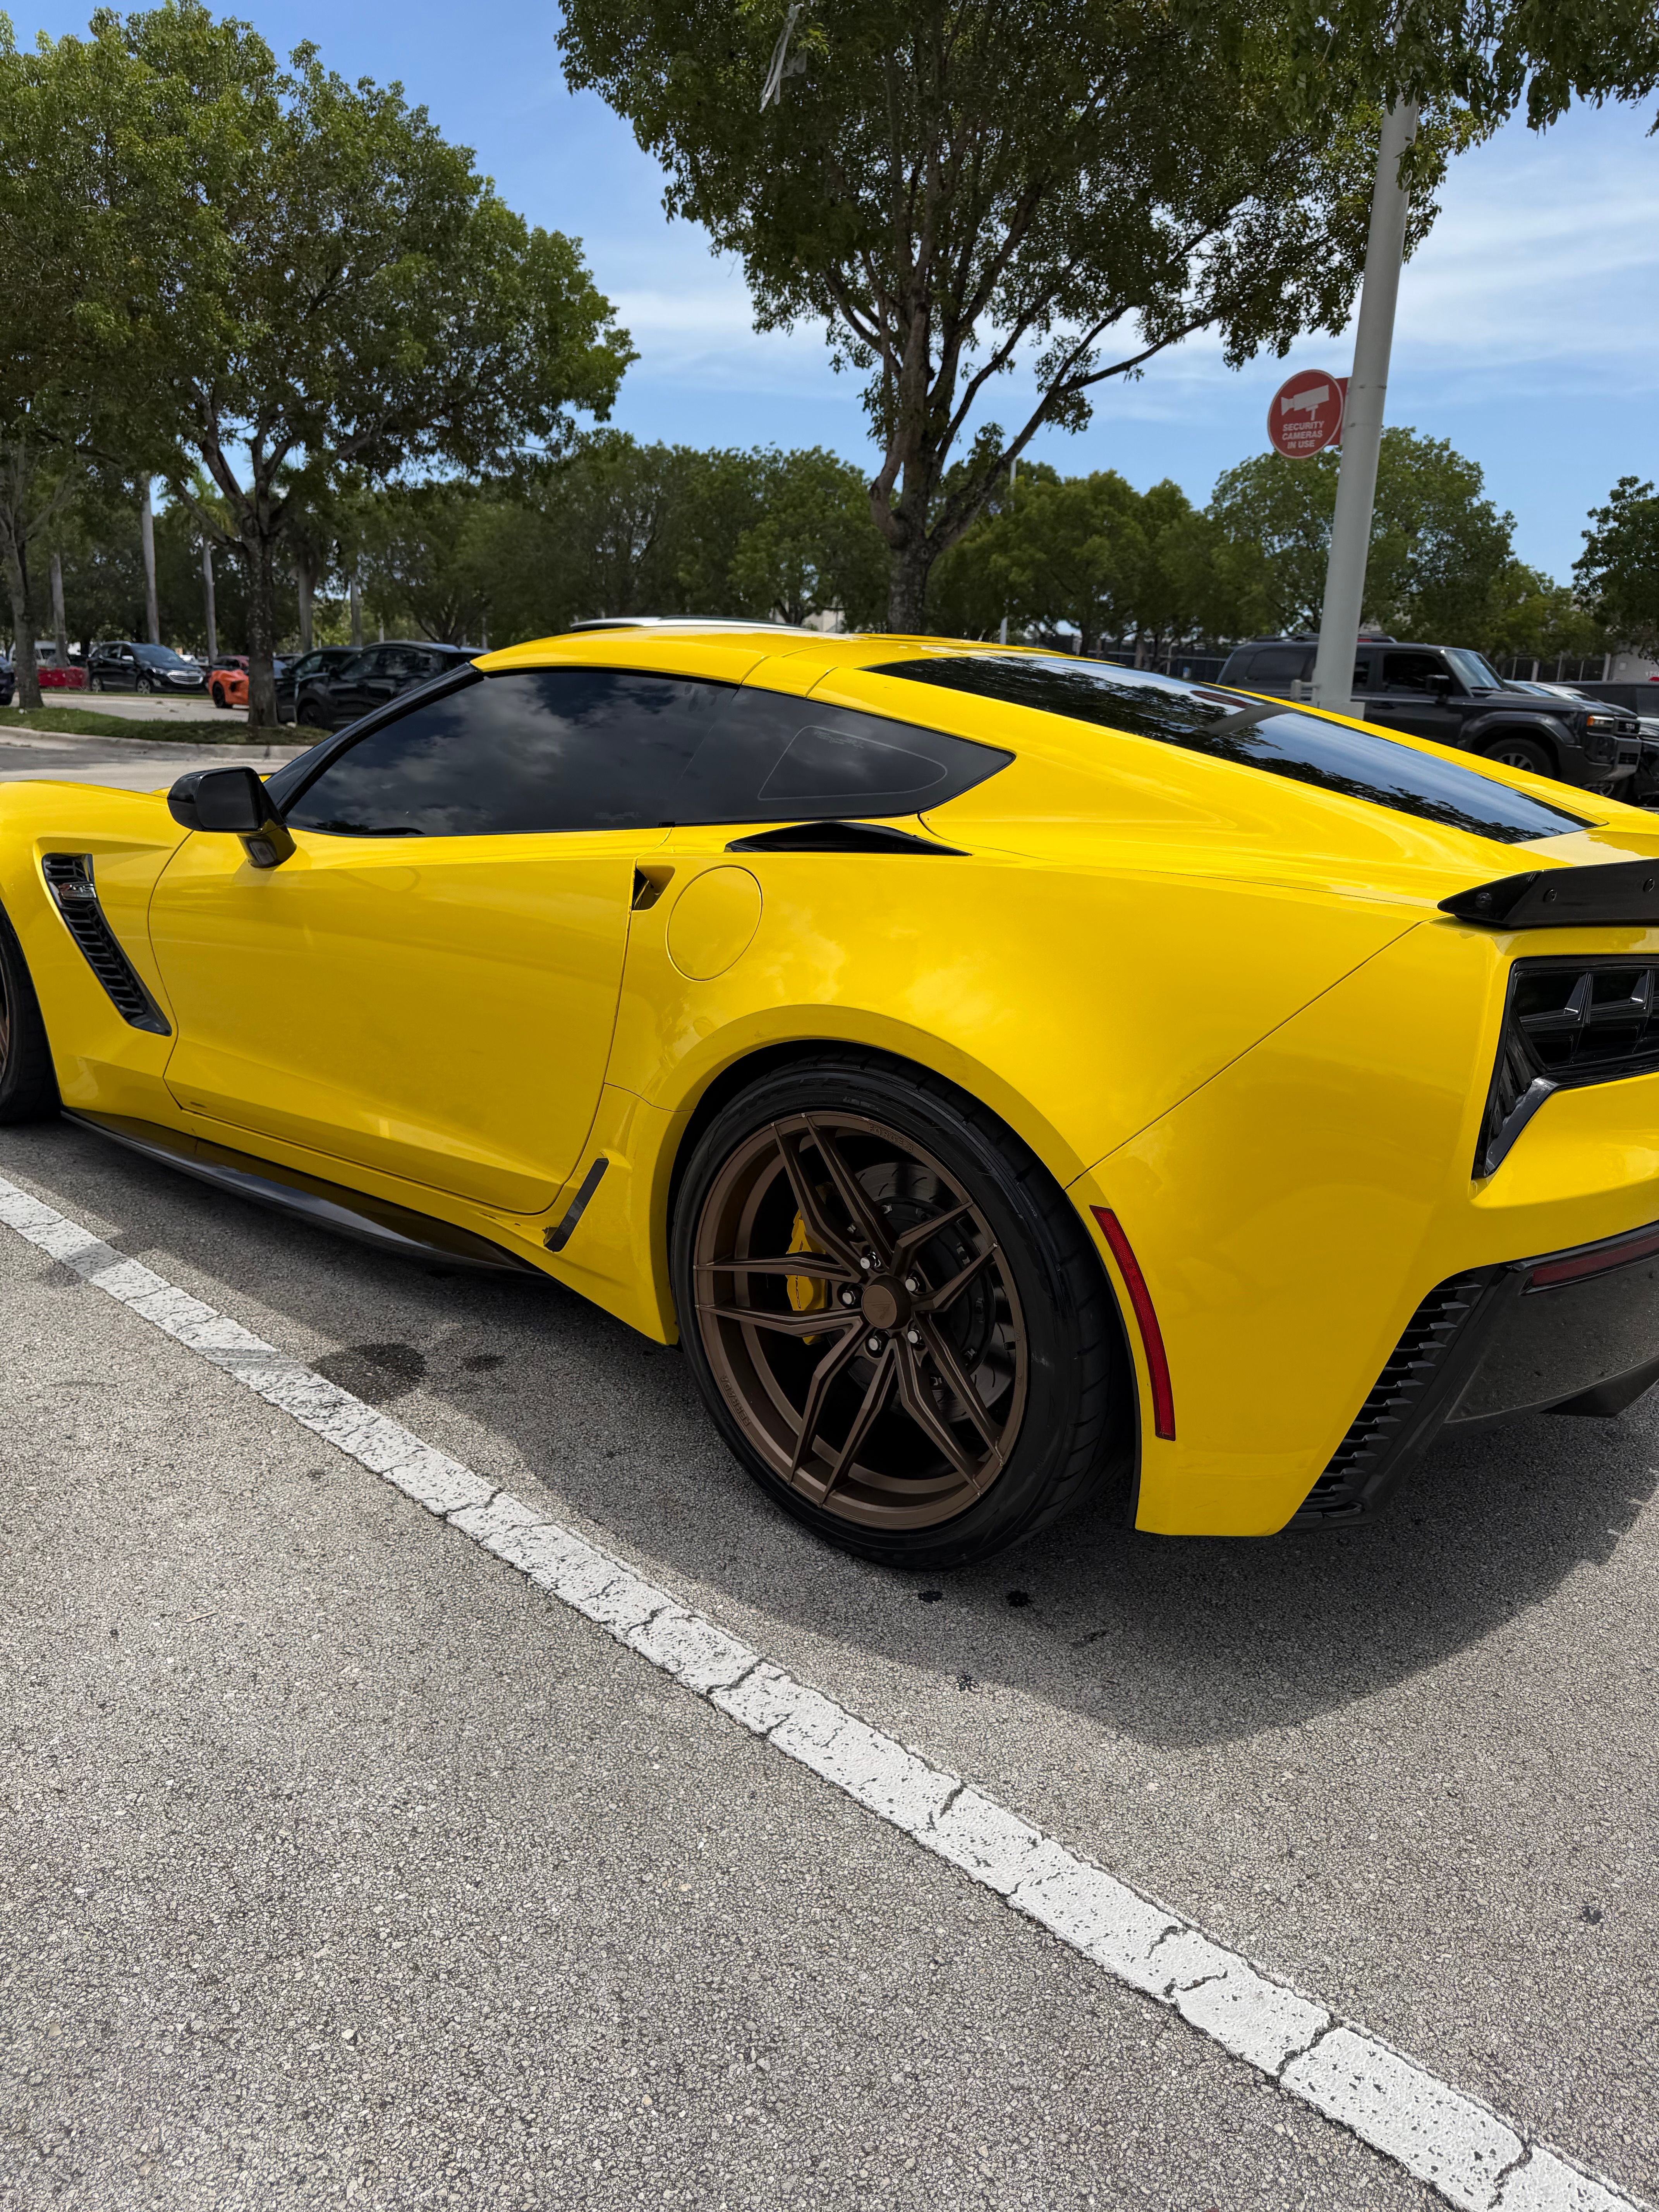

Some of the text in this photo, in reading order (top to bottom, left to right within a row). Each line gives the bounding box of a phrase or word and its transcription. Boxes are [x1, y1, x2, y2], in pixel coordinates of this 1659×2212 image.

[1283, 420, 1324, 431] SECURITY
[1282, 430, 1322, 440] CAMERAS
[1287, 440, 1316, 449] IN USE
[720, 1374, 751, 1427] FERRADA
